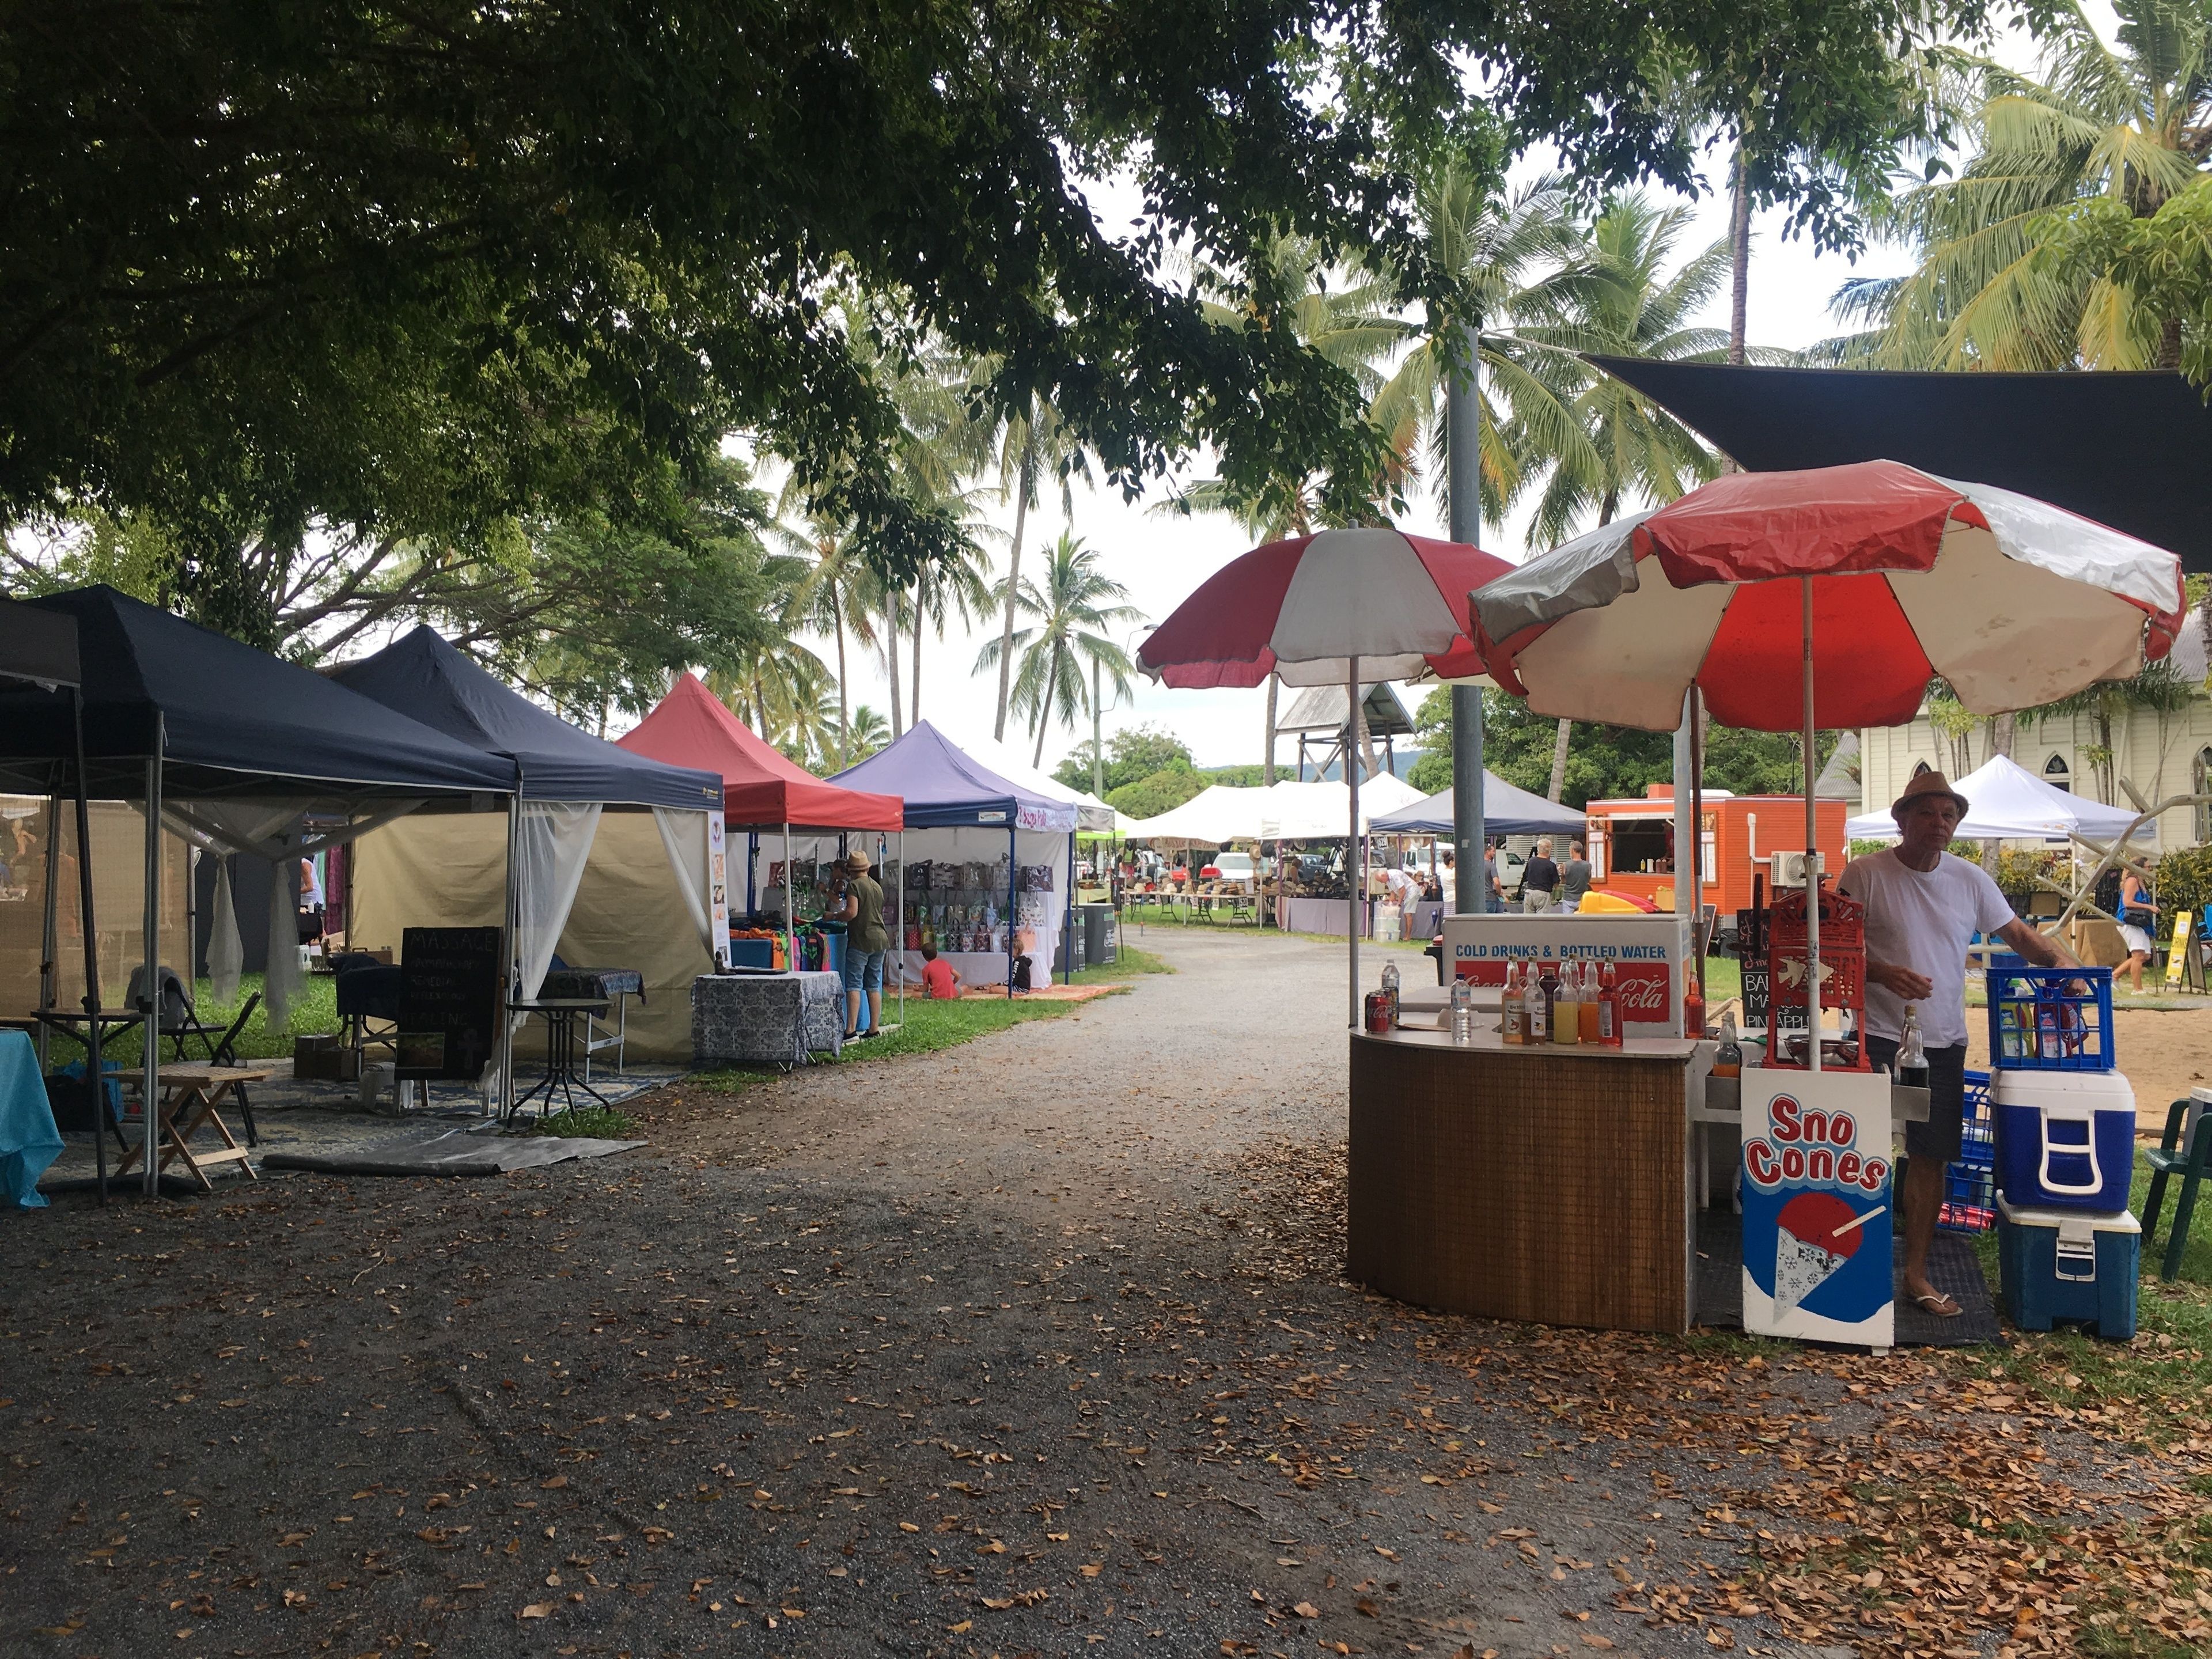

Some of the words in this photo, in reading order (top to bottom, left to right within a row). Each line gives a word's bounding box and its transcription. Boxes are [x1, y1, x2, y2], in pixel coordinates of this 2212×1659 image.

[410, 931, 494, 952] MASSAGE
[1456, 945, 1487, 957] COLD
[1492, 945, 1538, 957] DRINKS
[1543, 945, 1552, 957] &
[1560, 945, 1616, 959] BOTTLED
[1622, 946, 1666, 959] WATER
[1771, 1096, 1855, 1146] Sno
[1745, 1139, 1887, 1191] Cones
